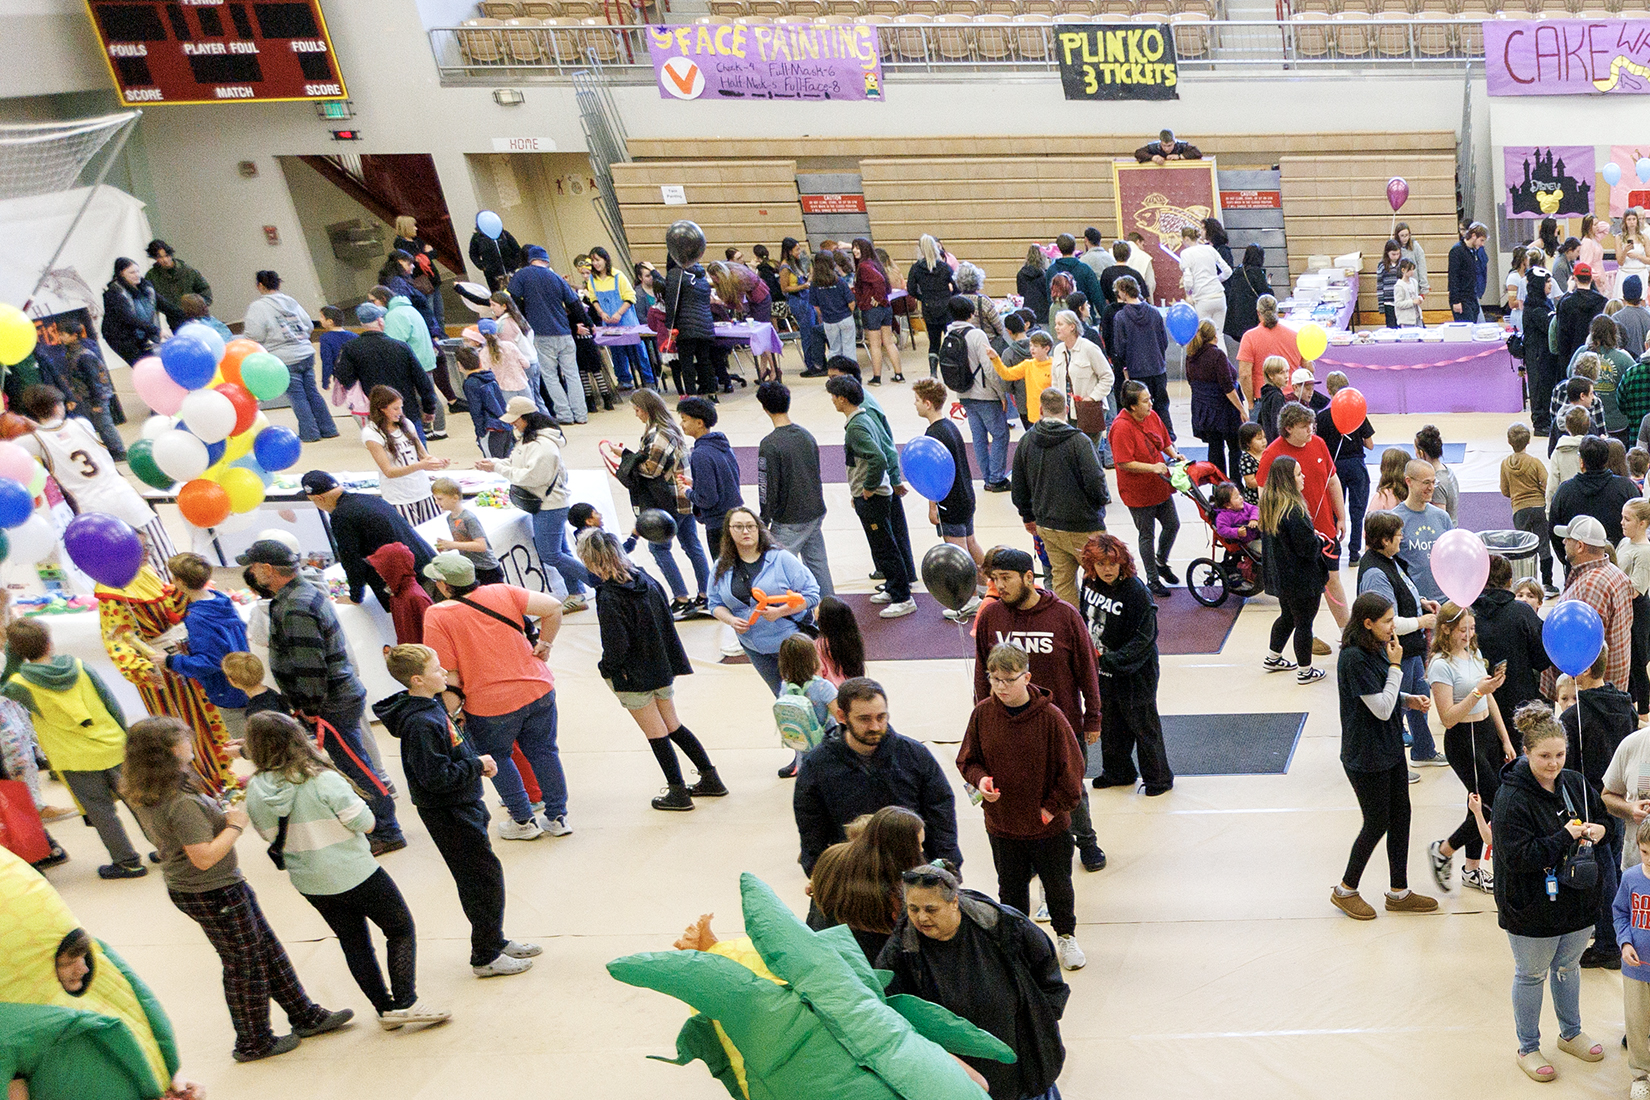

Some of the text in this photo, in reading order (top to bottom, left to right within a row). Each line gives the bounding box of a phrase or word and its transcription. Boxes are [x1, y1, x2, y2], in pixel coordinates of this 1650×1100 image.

[109, 44, 148, 56] FOULS
[184, 42, 260, 55] PLAYER FOUL
[291, 41, 327, 52] FOULS
[675, 25, 748, 58] FACE
[1059, 28, 1164, 65] PLINKO
[1504, 24, 1610, 84] CAKE
[1082, 62, 1177, 94] 3 TICKETS
[125, 89, 164, 101] SCORE
[215, 87, 254, 98] MATCH
[305, 84, 342, 96] SCORE
[510, 138, 539, 150] HOME
[70, 450, 99, 478] 3
[1084, 586, 1124, 616] TUPAC
[995, 631, 1054, 654] VANS
